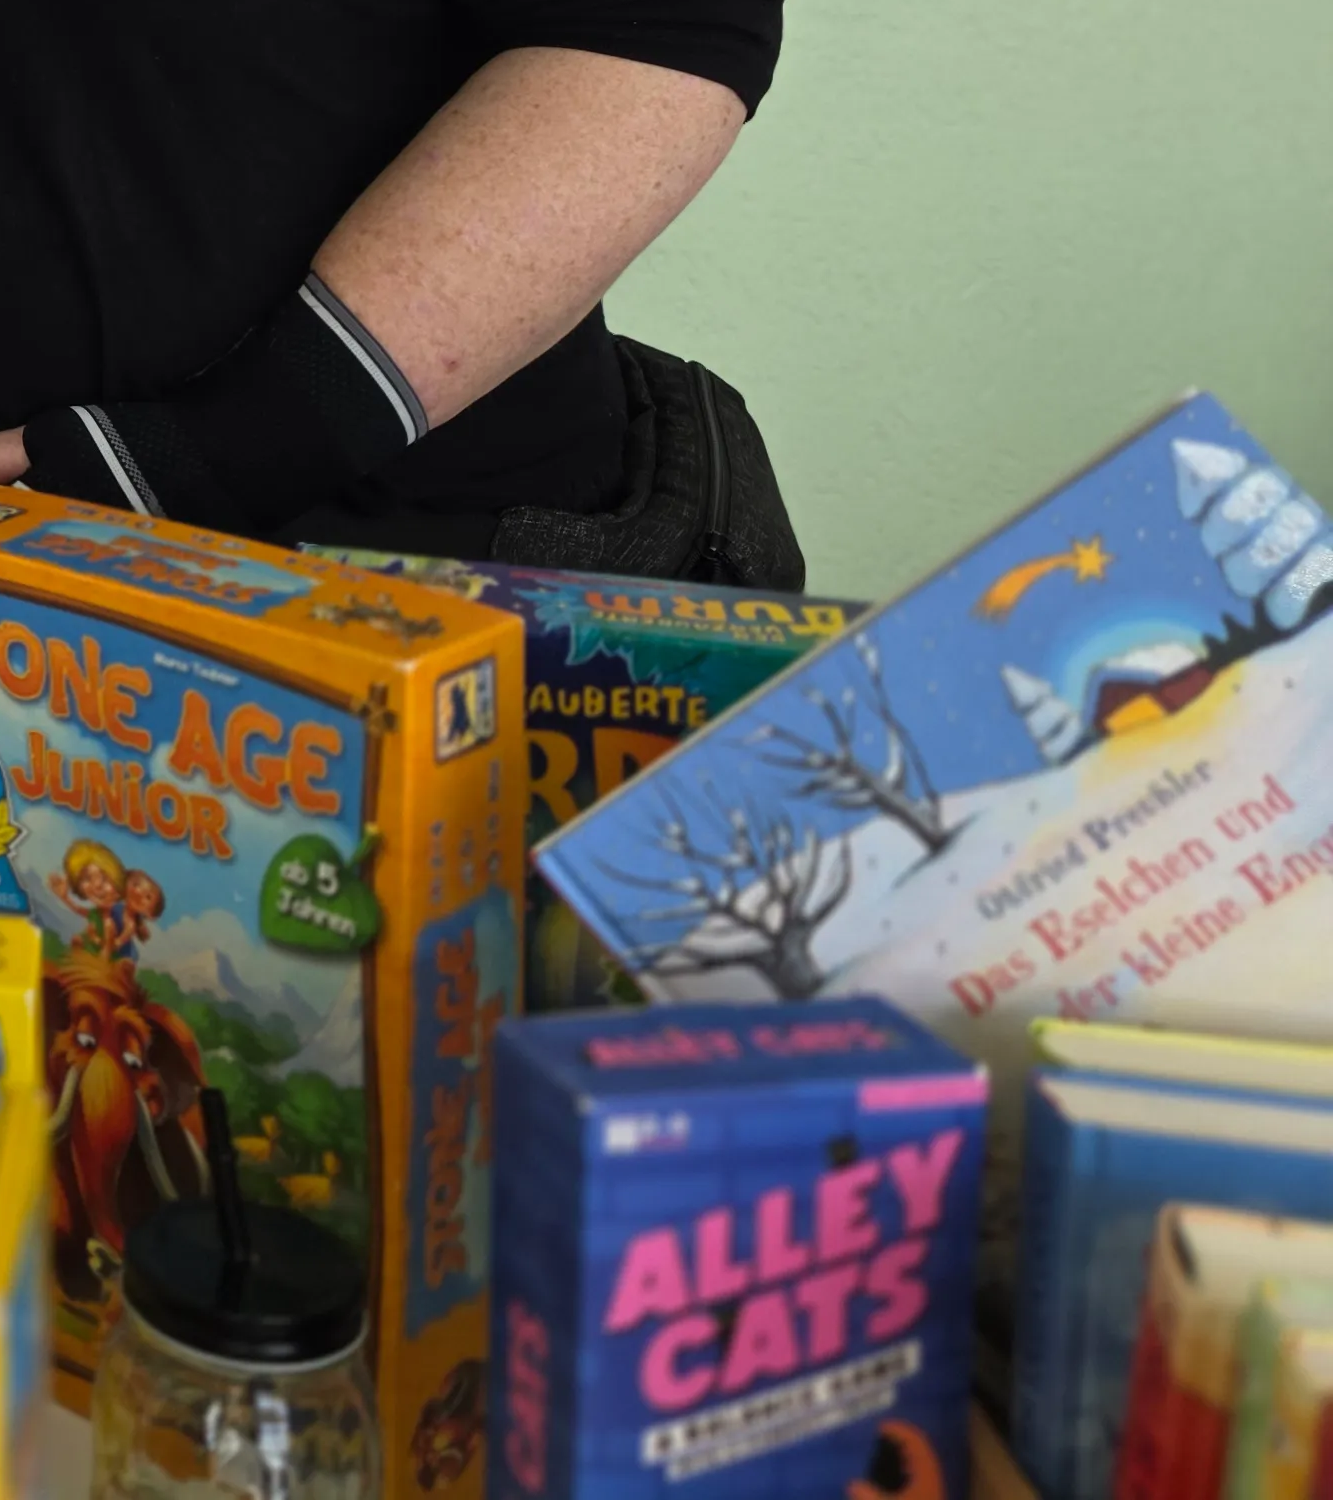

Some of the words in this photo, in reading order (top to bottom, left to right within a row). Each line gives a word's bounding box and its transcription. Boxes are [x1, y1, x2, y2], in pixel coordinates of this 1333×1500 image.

[169, 689, 342, 815] AGE
[526, 683, 708, 728] AUBERTE
[276, 888, 357, 940] Jahren
[280, 858, 309, 886] ab
[317, 861, 339, 896] 5
[948, 949, 1037, 1019] Das
[1027, 837, 1217, 963] Eselchen
[1213, 772, 1298, 843] und
[1055, 972, 1120, 1025] der
[1119, 895, 1246, 988] kleine
[603, 1129, 965, 1334] ALLEY
[639, 1239, 928, 1413] CATS
